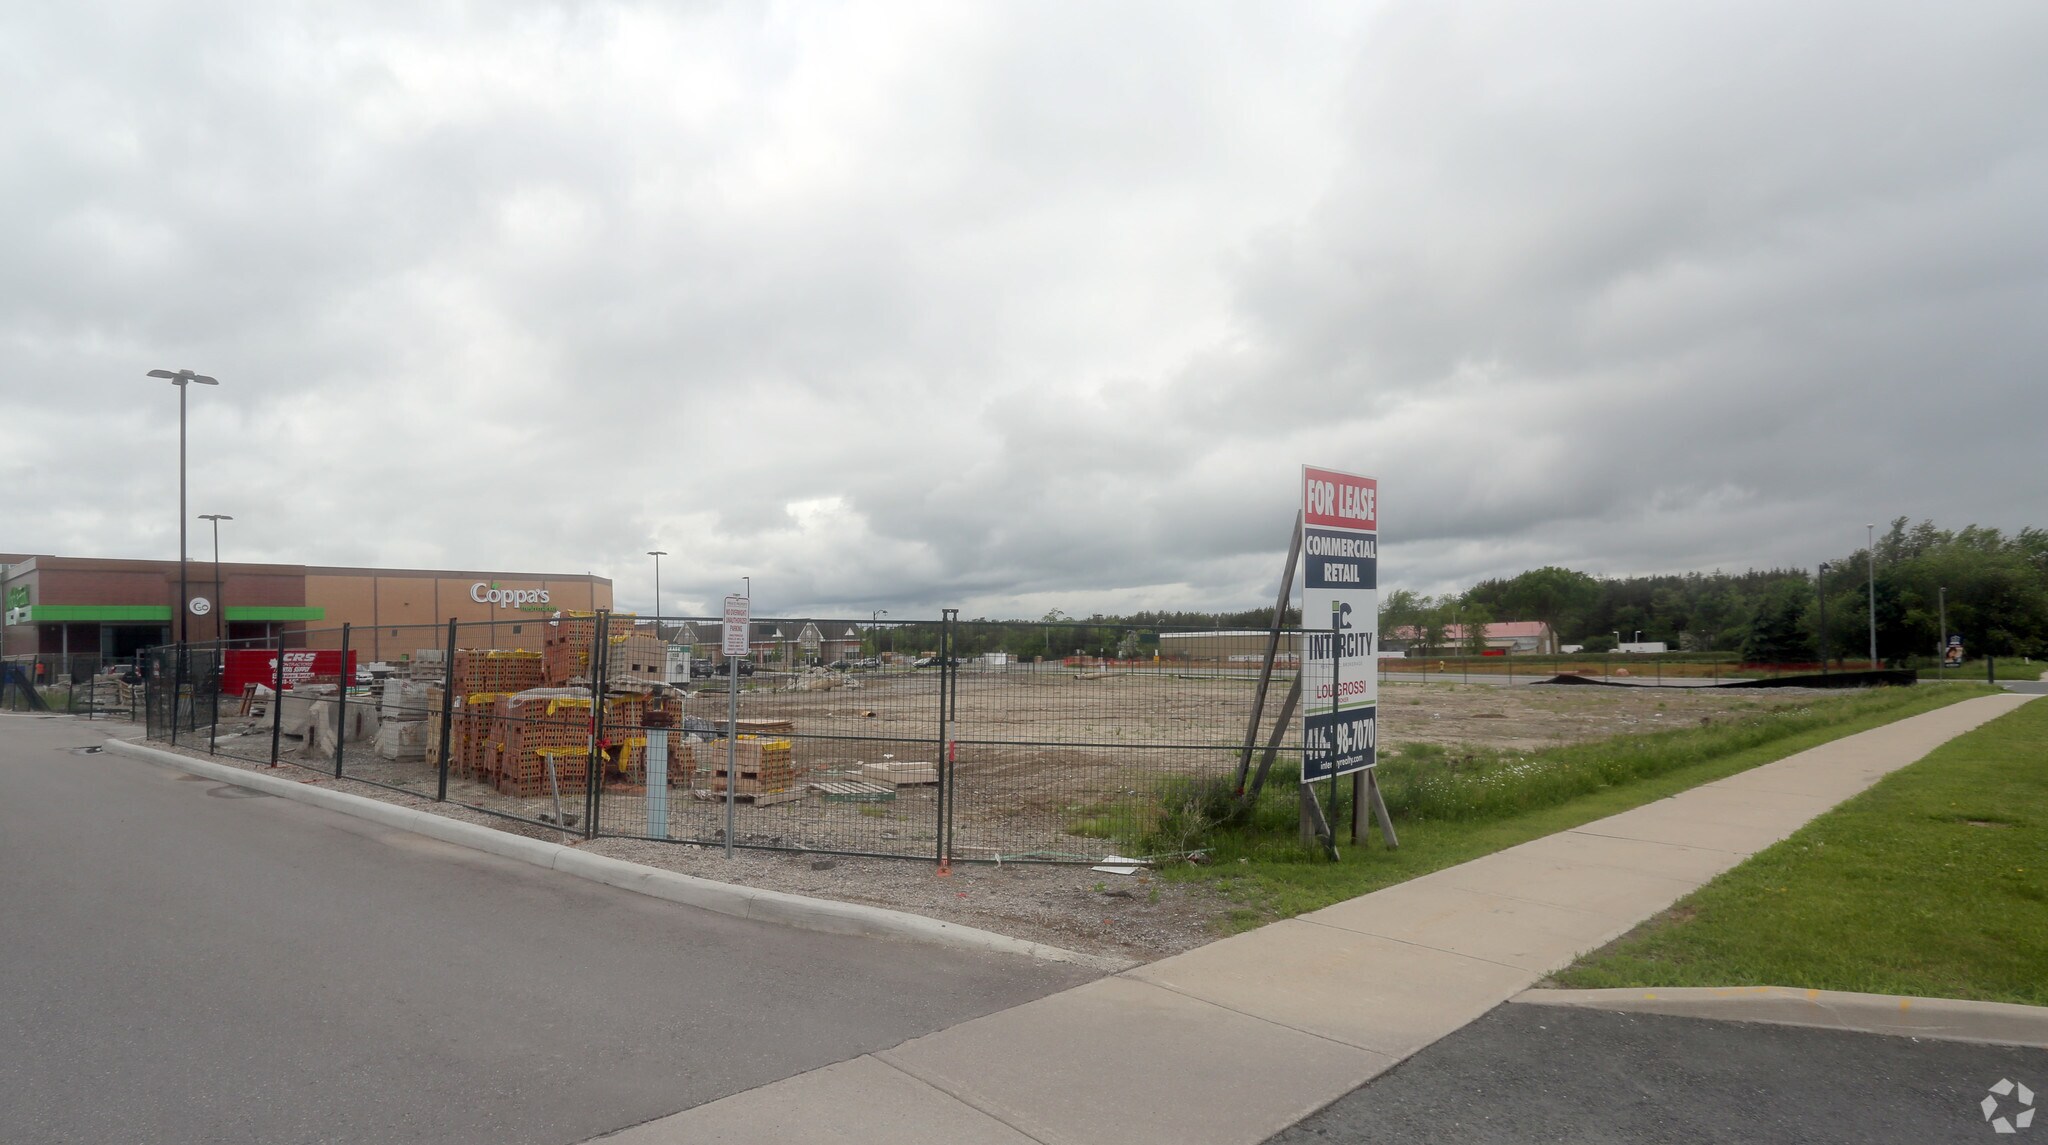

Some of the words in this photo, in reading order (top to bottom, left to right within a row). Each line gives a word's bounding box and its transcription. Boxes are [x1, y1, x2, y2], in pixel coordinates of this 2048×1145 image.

[1307, 480, 1334, 516] FOR
[1338, 484, 1375, 521] LEASE
[1306, 535, 1375, 559] COMMERCIAL
[1324, 563, 1360, 583] RETAIL
[470, 582, 550, 608] Coppa's
[283, 653, 316, 661] CRS
[1309, 632, 1373, 660] INTRCITY
[1316, 684, 1334, 699] LOU
[1337, 680, 1367, 697] GROSSI
